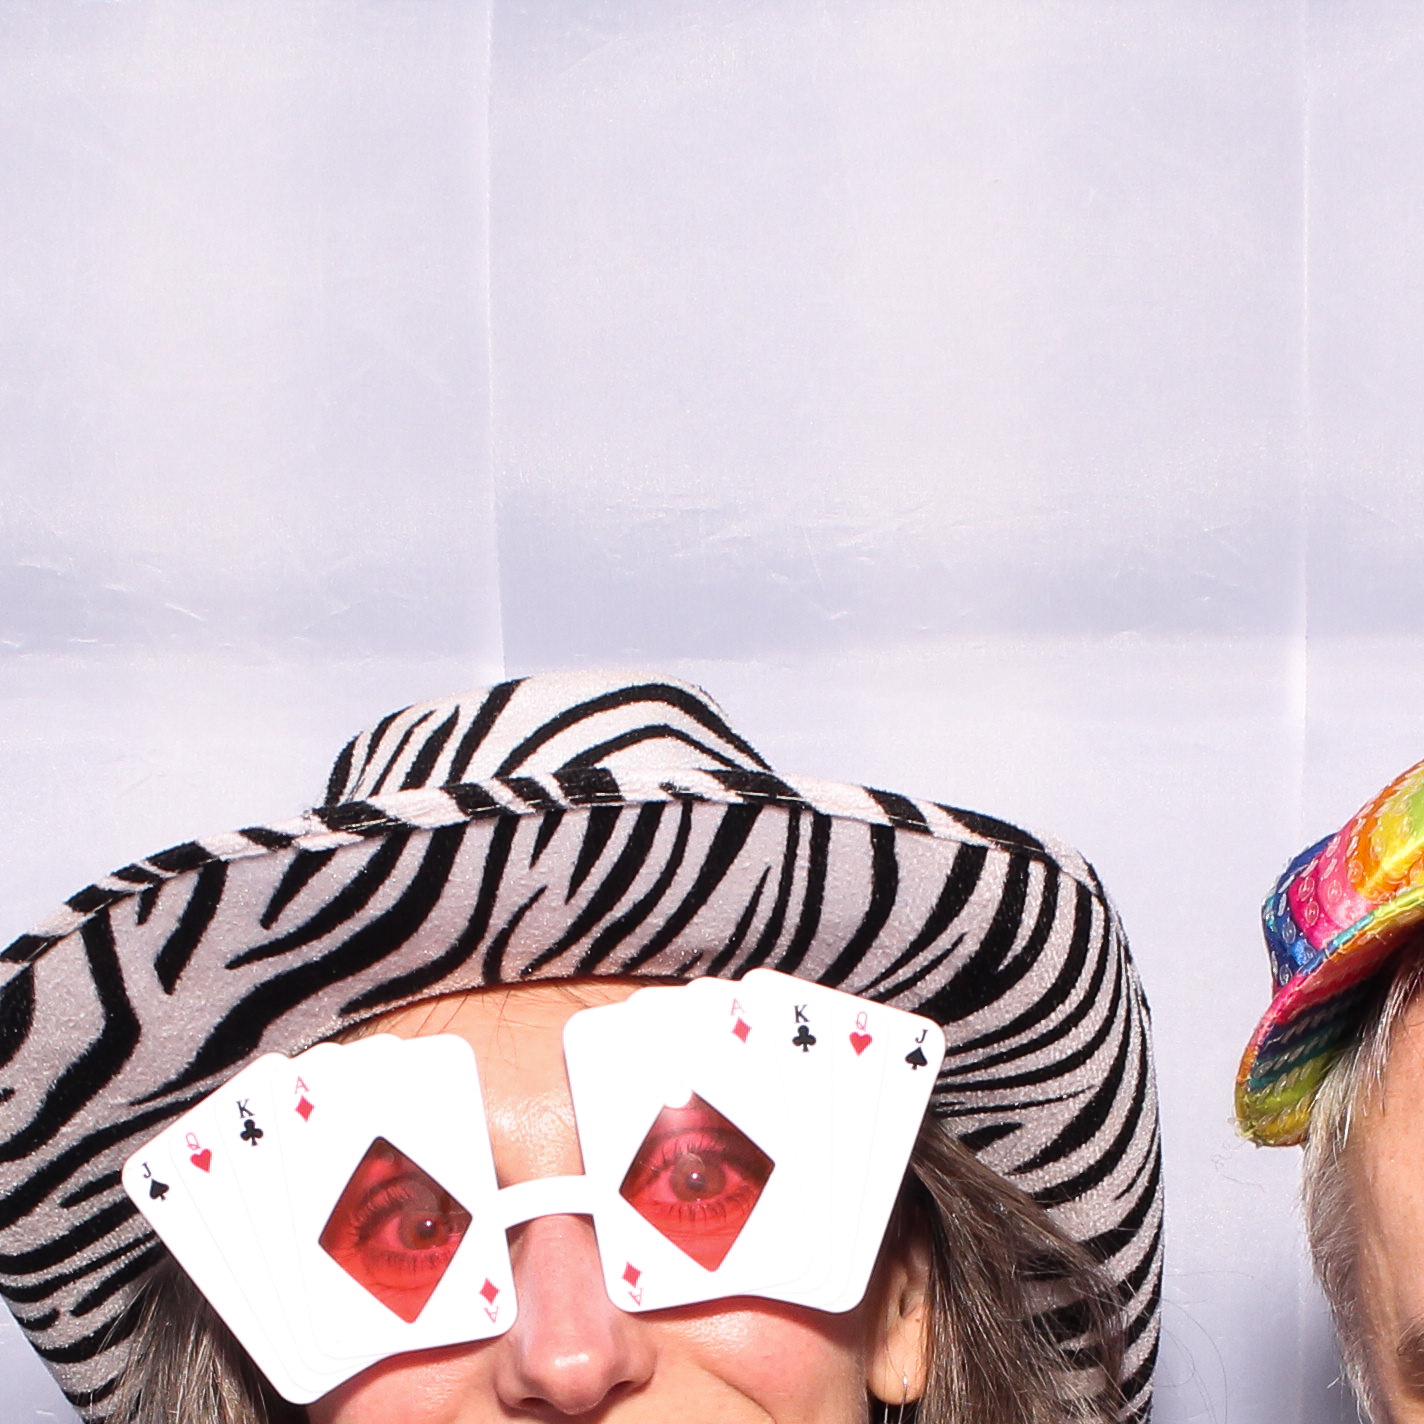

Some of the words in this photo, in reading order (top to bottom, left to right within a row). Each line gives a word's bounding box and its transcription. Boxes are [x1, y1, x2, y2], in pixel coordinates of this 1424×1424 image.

[730, 998, 746, 1016] A
[794, 1004, 811, 1024] K
[855, 1011, 869, 1032] Q
[914, 1028, 929, 1044] J
[294, 1076, 310, 1095] A
[235, 1098, 255, 1119] K
[184, 1132, 201, 1151] Q
[141, 1162, 152, 1179] J
[626, 1287, 644, 1307] A
[483, 1305, 499, 1324] A
